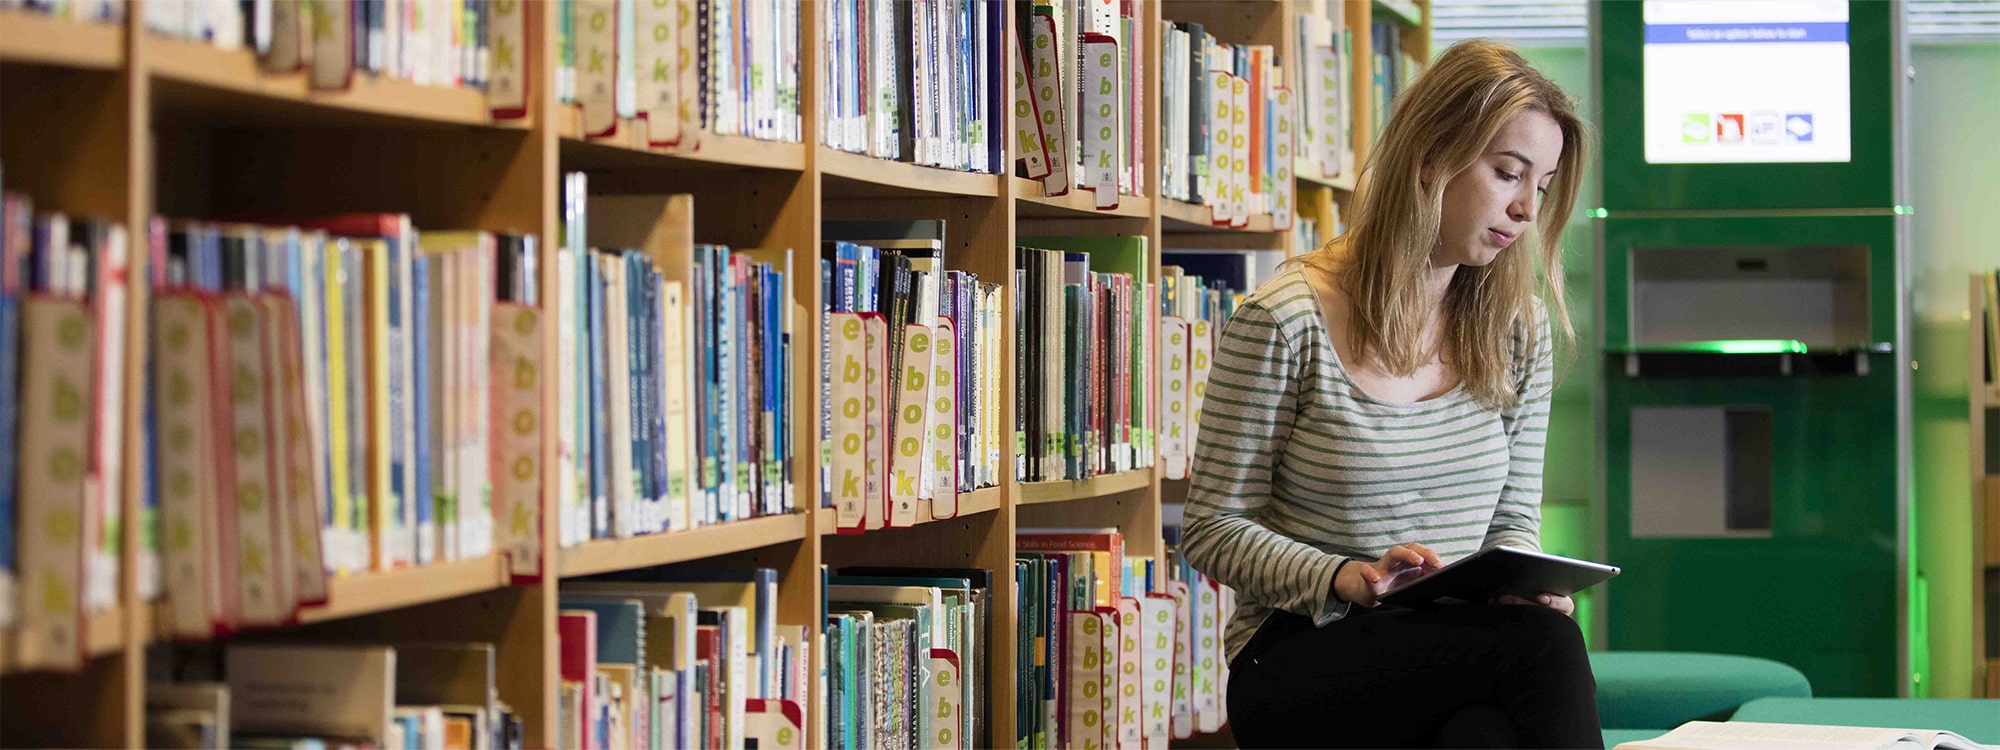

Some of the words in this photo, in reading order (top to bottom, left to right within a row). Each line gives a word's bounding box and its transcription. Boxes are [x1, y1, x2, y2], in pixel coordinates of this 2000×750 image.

[1036, 33, 1058, 153] ebook
[1099, 53, 1112, 168] ebook
[1216, 74, 1229, 198] ebook
[1233, 81, 1245, 202] ebook
[1277, 91, 1289, 208] ebook
[843, 267, 854, 313] PERRY
[842, 319, 861, 498] ebook
[896, 333, 929, 497] ebook
[935, 338, 952, 471] ebook
[1170, 332, 1182, 439] ebook
[1194, 320, 1207, 424] ebo
[920, 625, 930, 688] TEA
[1123, 612, 1135, 724] ebook
[1152, 610, 1168, 719] ebook
[1202, 591, 1213, 695] ebook
[937, 670, 952, 744] ebo
